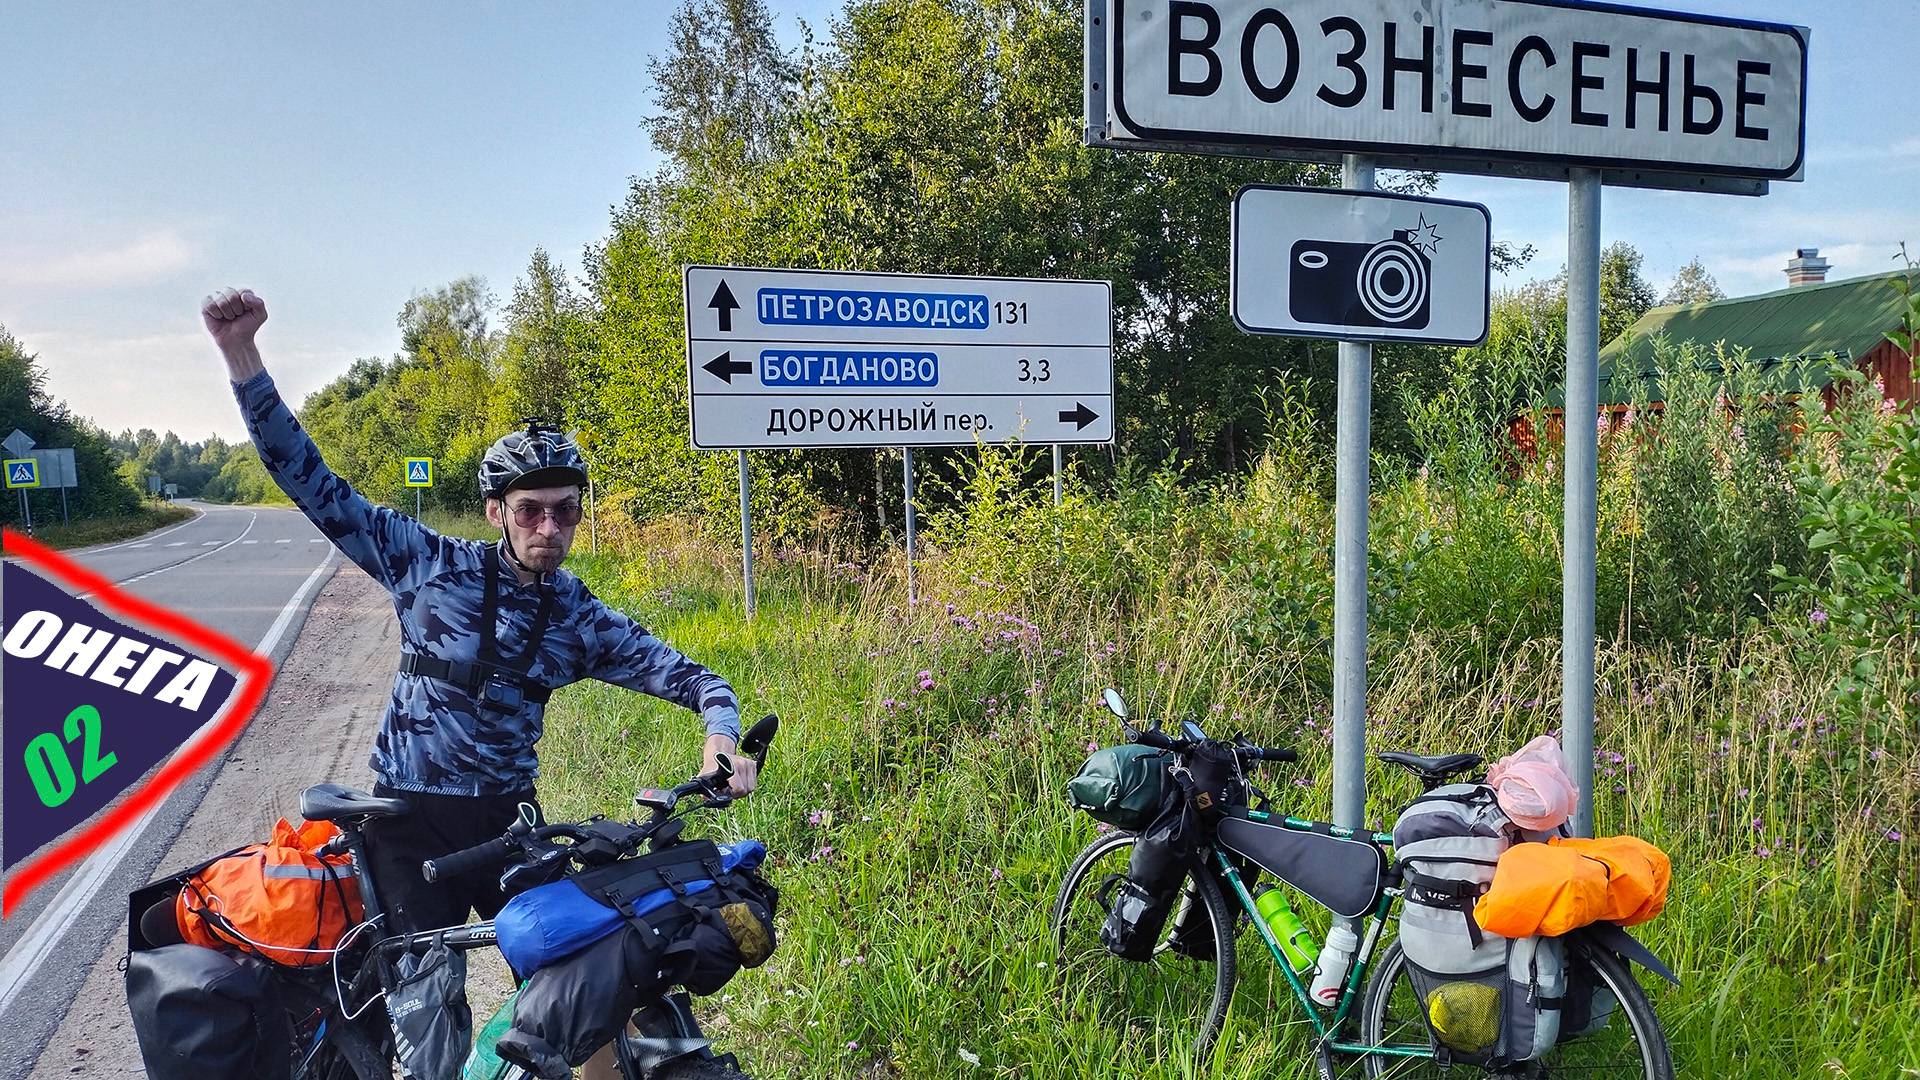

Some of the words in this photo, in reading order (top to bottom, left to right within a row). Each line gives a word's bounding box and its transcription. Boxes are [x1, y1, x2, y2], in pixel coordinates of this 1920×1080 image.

[1167, 0, 1772, 141] ВОЗНЕСЕНЬЕ
[761, 294, 985, 327] ПЕТРОЗАВОДСК
[994, 301, 1028, 325] 131
[763, 356, 936, 385] БОГДАНОВО
[1017, 359, 1051, 385] 3,3
[766, 401, 936, 436] ДОРОЖНЫЙ
[944, 414, 994, 435] пер.
